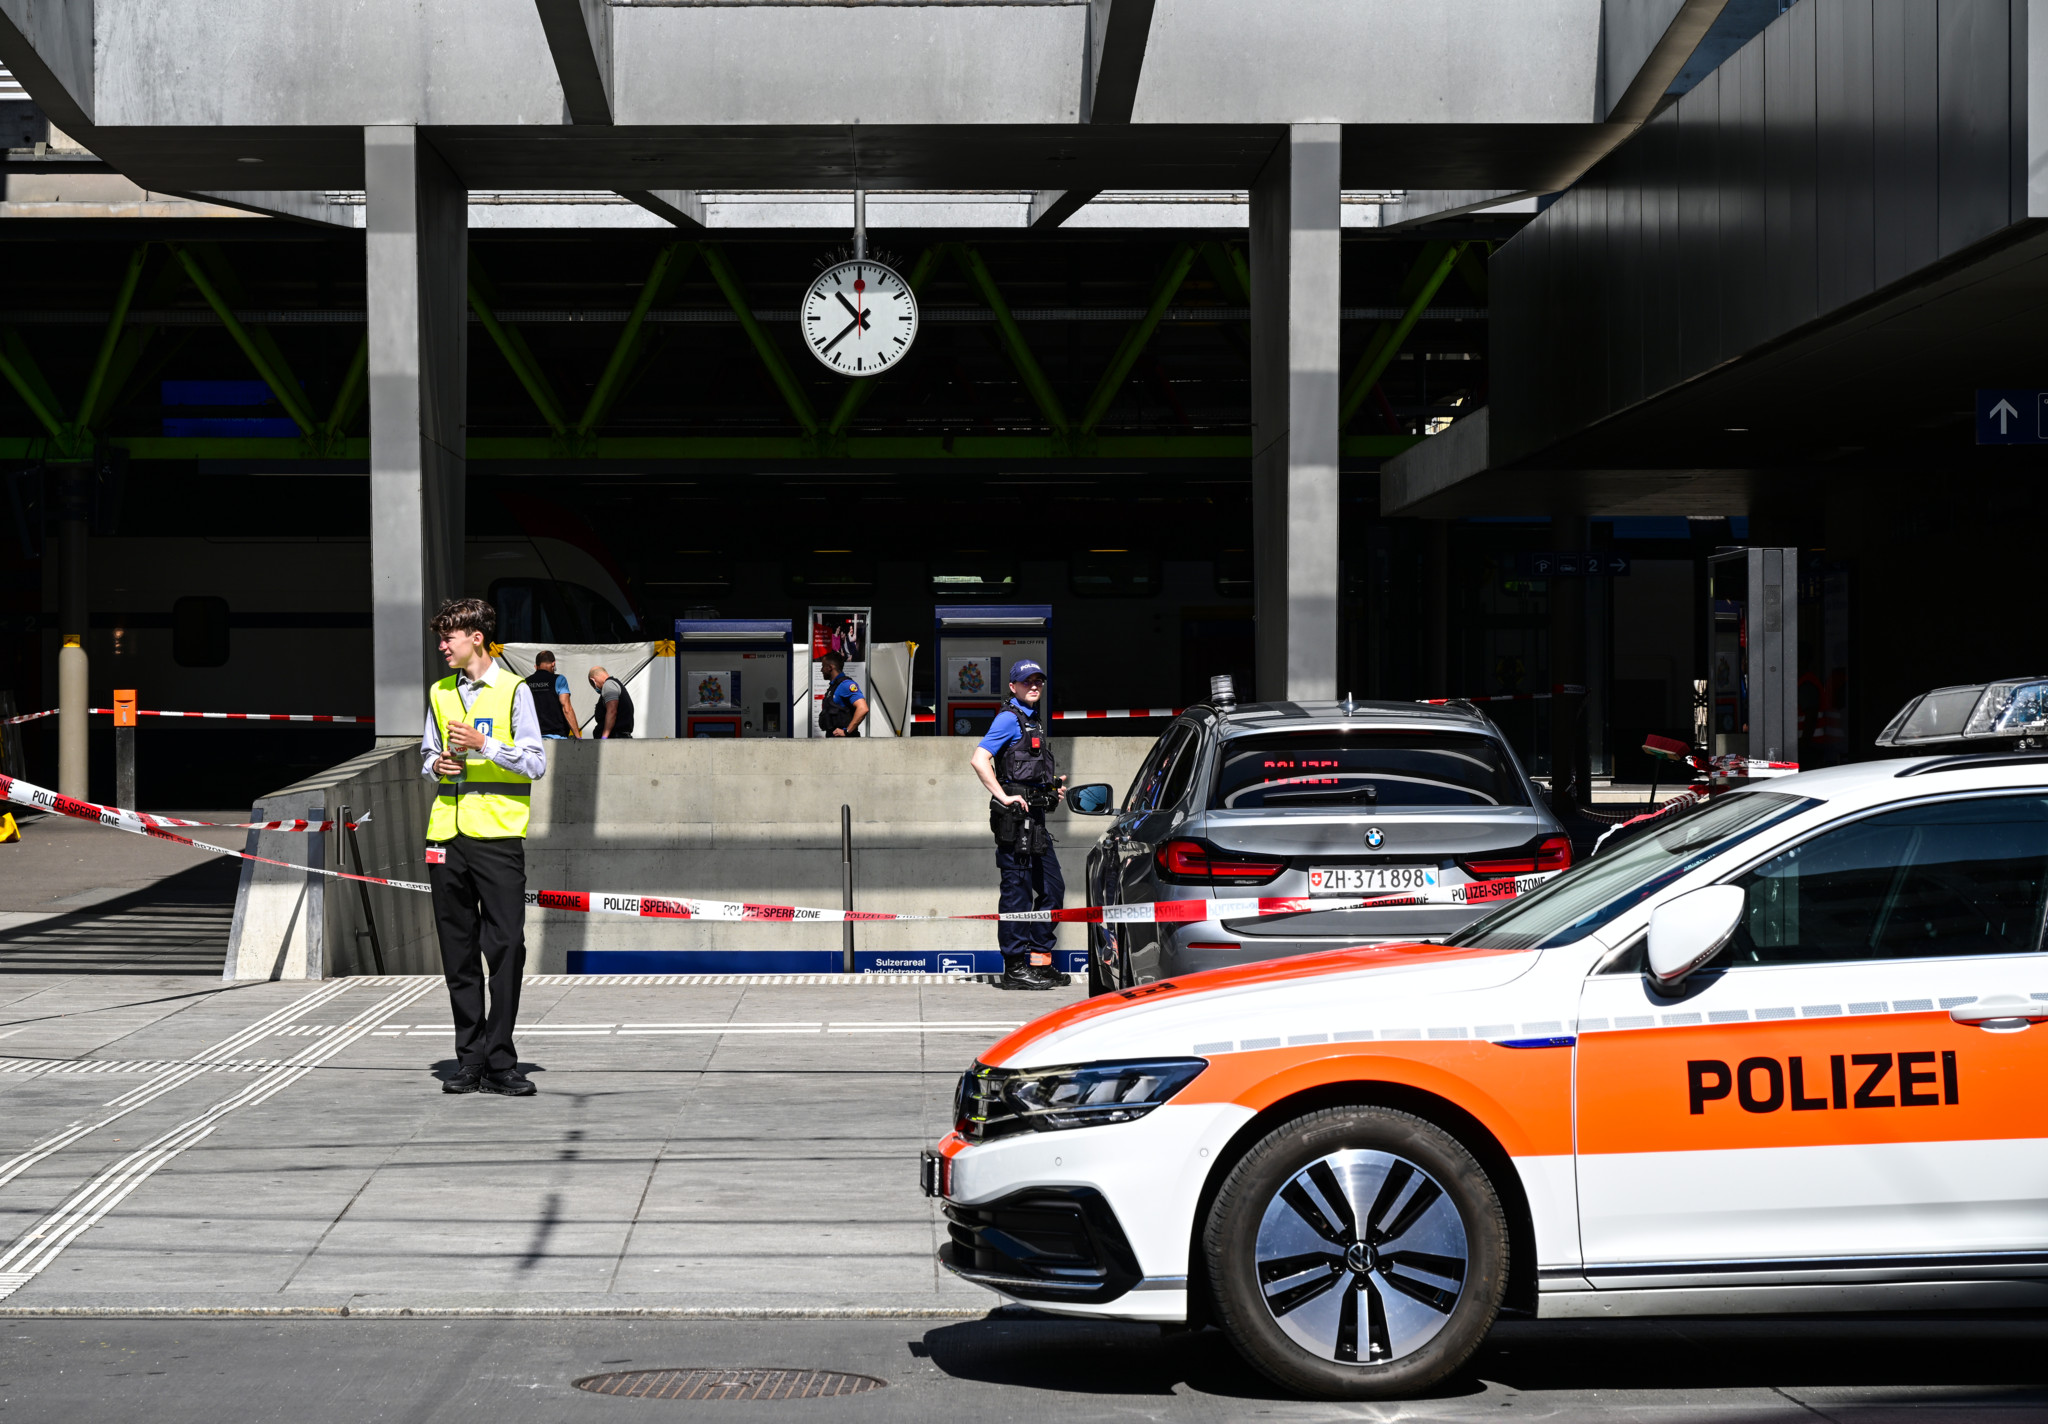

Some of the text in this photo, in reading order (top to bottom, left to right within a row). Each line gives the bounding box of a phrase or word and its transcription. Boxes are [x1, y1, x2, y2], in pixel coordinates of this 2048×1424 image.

[32, 790, 120, 827] POLIZEI-SPERRZONE
[525, 893, 581, 907] SPERRZONE
[604, 898, 700, 915] POLIZEI-SPERRZONE
[875, 958, 926, 967] Sulzerareal
[1686, 1050, 1960, 1115] POLIZEI
